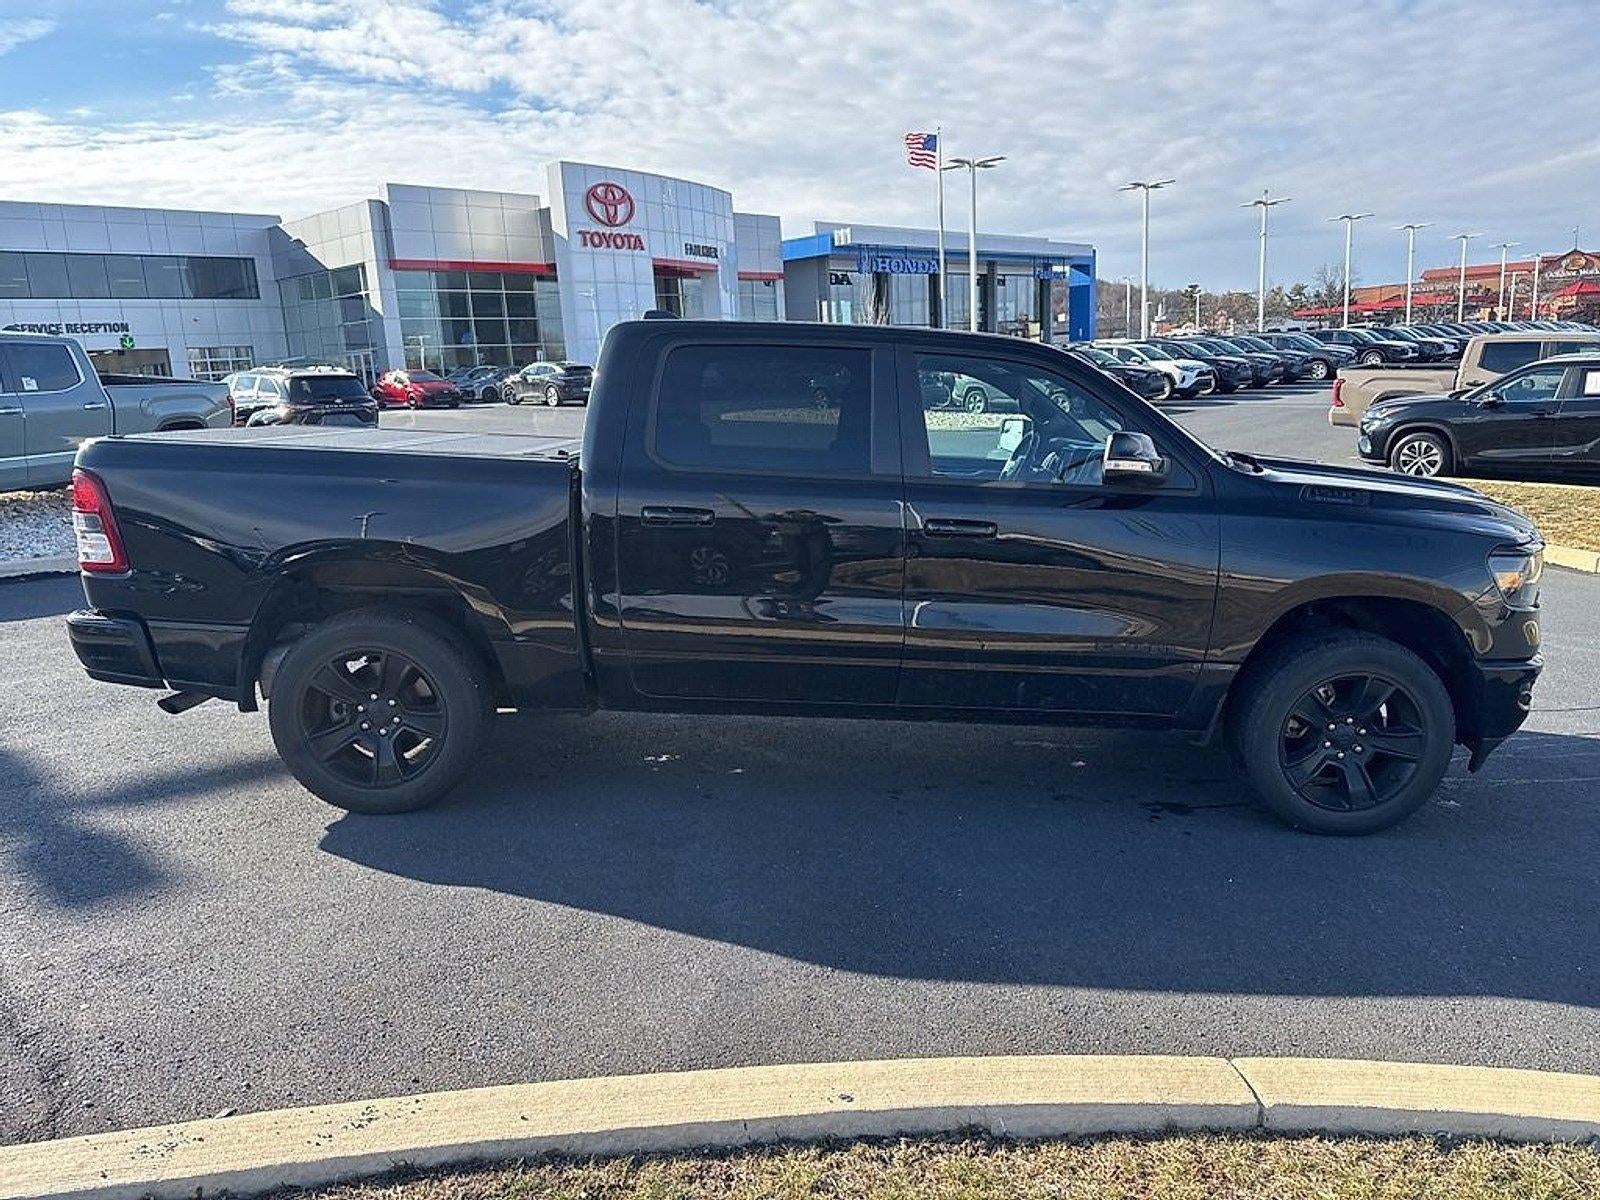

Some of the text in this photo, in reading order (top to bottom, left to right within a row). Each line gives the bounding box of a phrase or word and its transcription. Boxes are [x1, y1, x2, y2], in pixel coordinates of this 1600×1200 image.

[577, 229, 645, 251] TOYOTA
[876, 258, 938, 274] HONDA
[65, 322, 129, 333] RECEPTION
